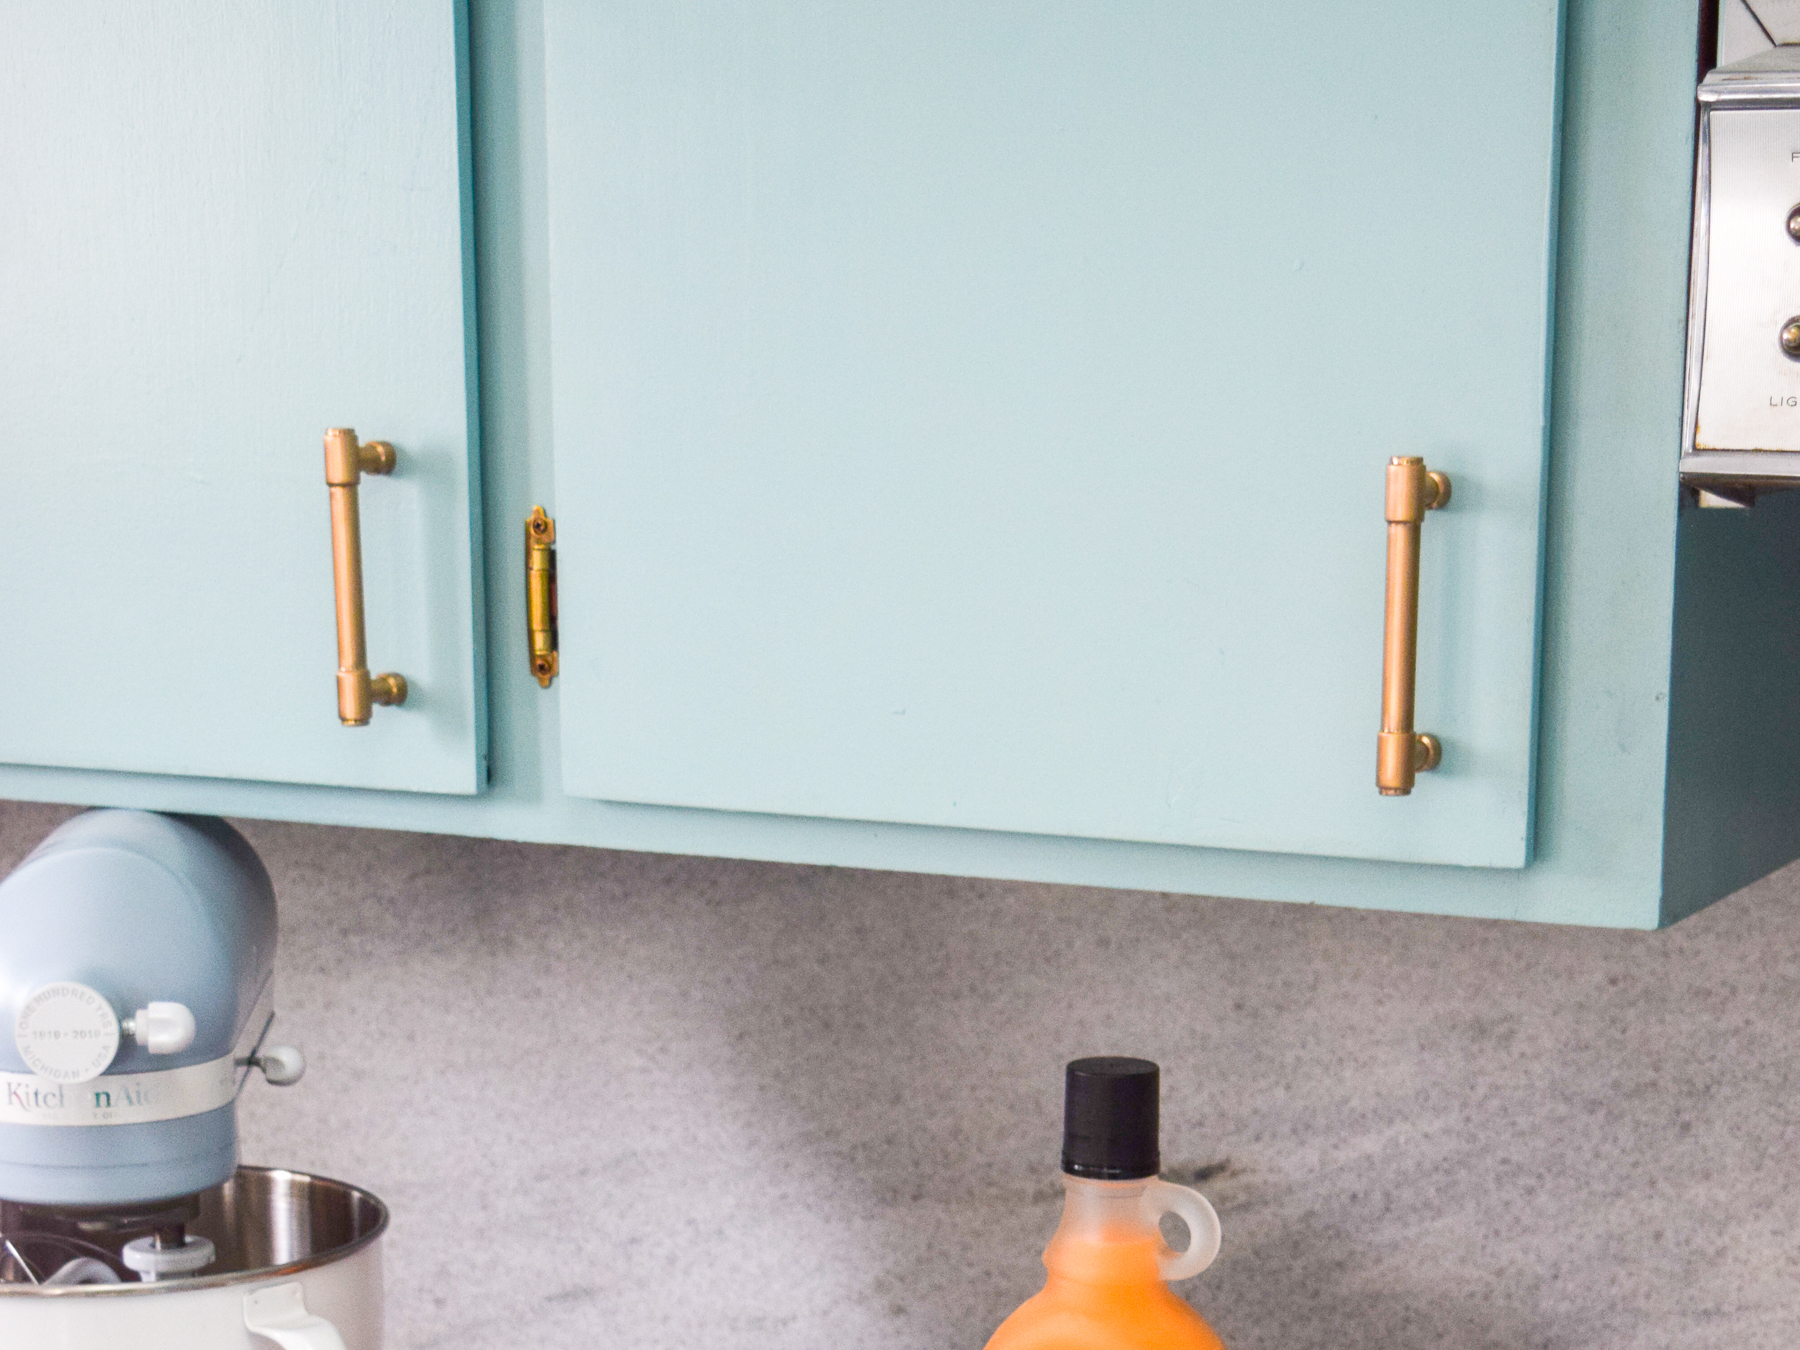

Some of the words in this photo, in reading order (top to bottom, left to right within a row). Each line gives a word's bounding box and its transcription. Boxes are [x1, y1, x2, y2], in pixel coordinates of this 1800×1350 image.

[22, 1045, 81, 1080] MICHIGAN
[91, 1044, 111, 1069] USA
[6, 1081, 153, 1112] KitcnAi
